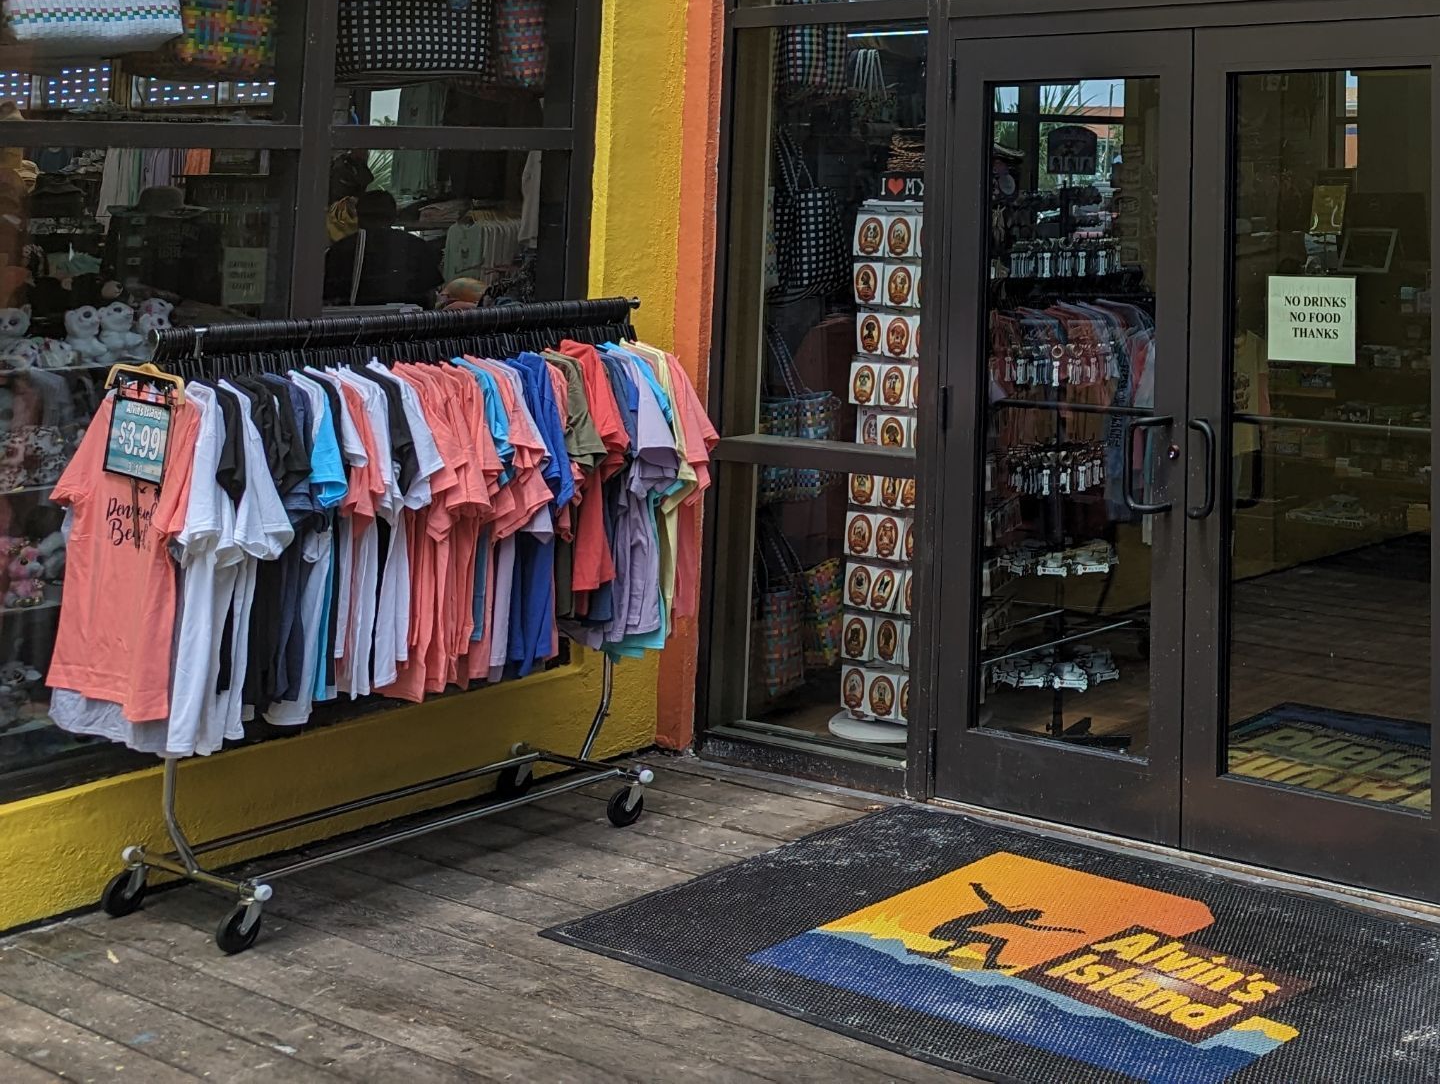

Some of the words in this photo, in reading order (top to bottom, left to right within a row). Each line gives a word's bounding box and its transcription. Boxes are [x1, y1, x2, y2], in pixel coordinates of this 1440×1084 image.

[880, 177, 887, 196] I
[1284, 296, 1301, 307] NO
[1303, 296, 1347, 308] DRINKS
[1289, 312, 1306, 323] NO
[1309, 312, 1341, 324] FOOD
[1292, 327, 1339, 340] THANKS
[118, 420, 161, 461] $3.99
[1090, 932, 1281, 1003] Alvin's
[1044, 953, 1243, 1030] Island
